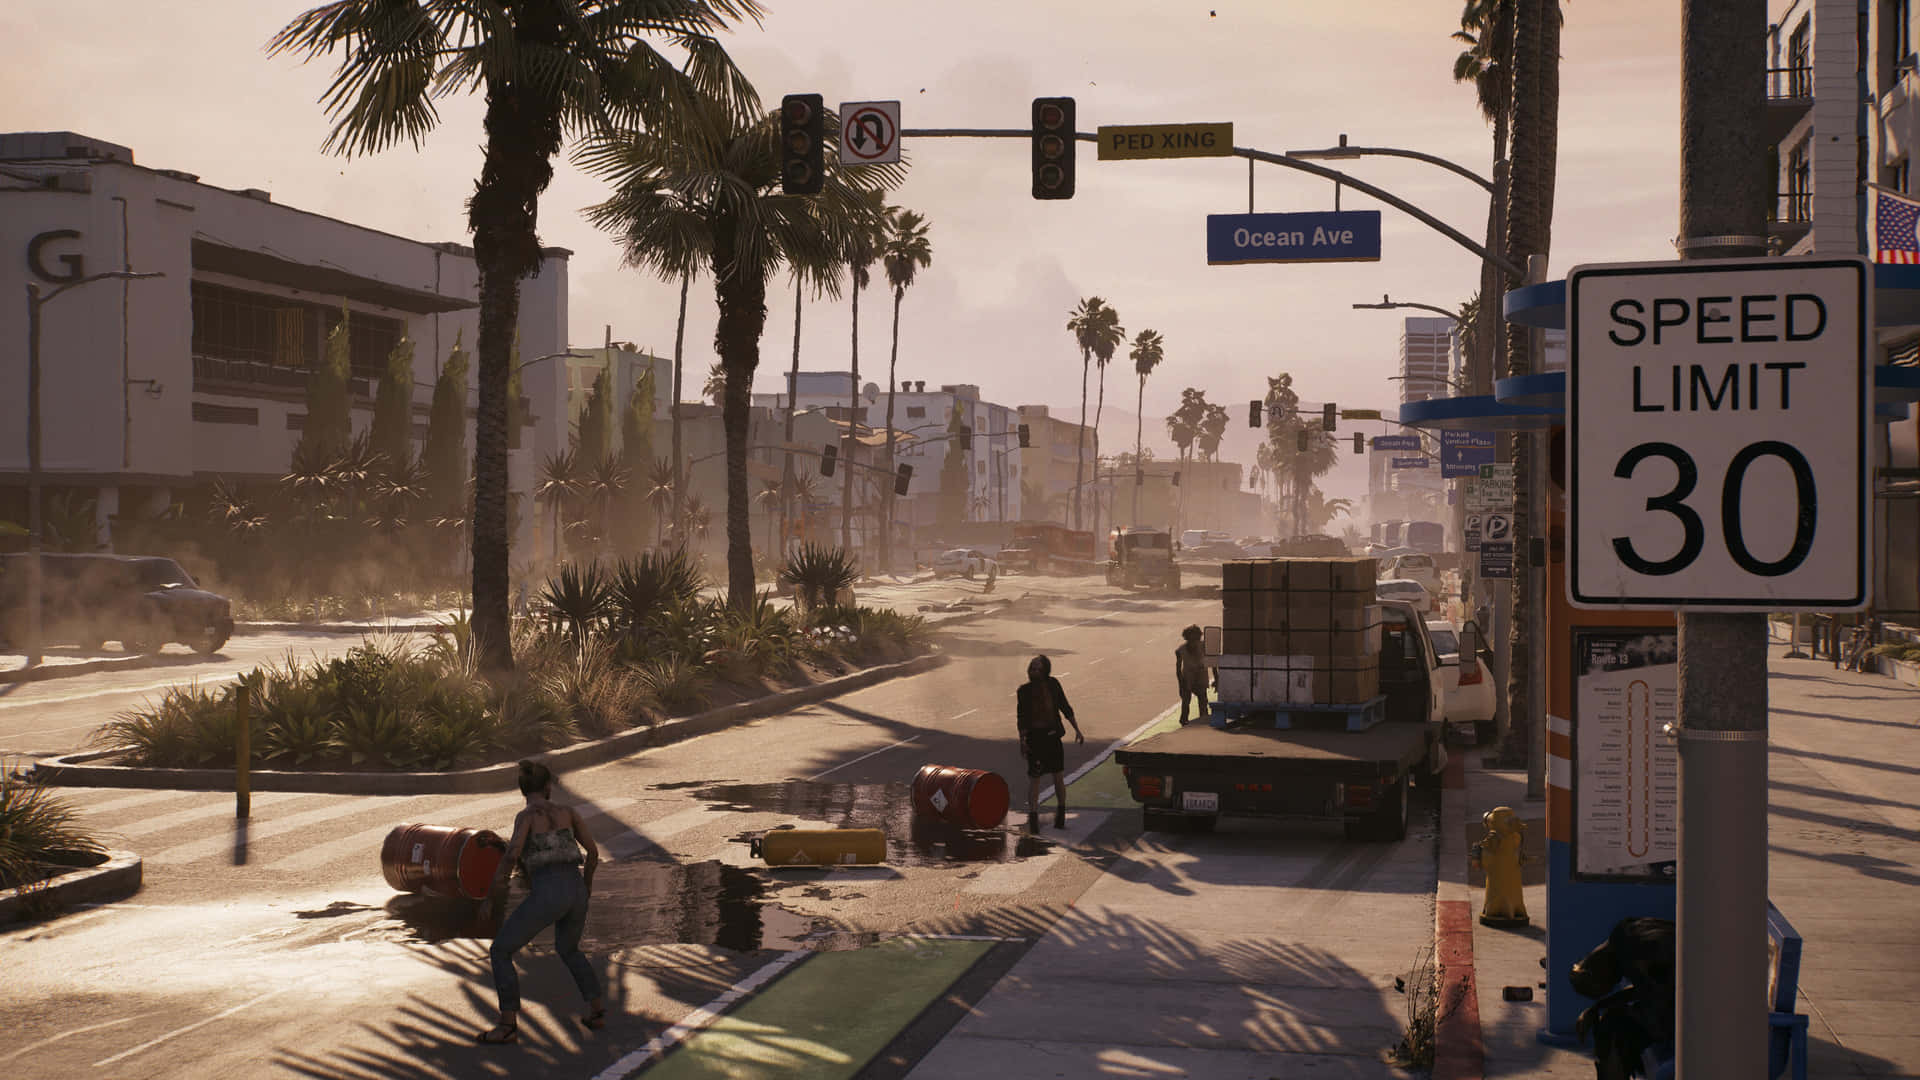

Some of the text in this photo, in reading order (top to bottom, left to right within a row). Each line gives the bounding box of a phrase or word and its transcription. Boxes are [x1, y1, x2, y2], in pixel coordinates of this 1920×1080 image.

[1112, 131, 1216, 151] PED XING
[1233, 226, 1354, 248] Ocean Ave
[27, 229, 84, 284] G
[1608, 293, 1828, 347] SPEED
[1632, 362, 1807, 412] LIMIT
[1481, 480, 1512, 489] PARKING
[1611, 440, 1818, 577] 30
[1591, 654, 1629, 665] Route 13
